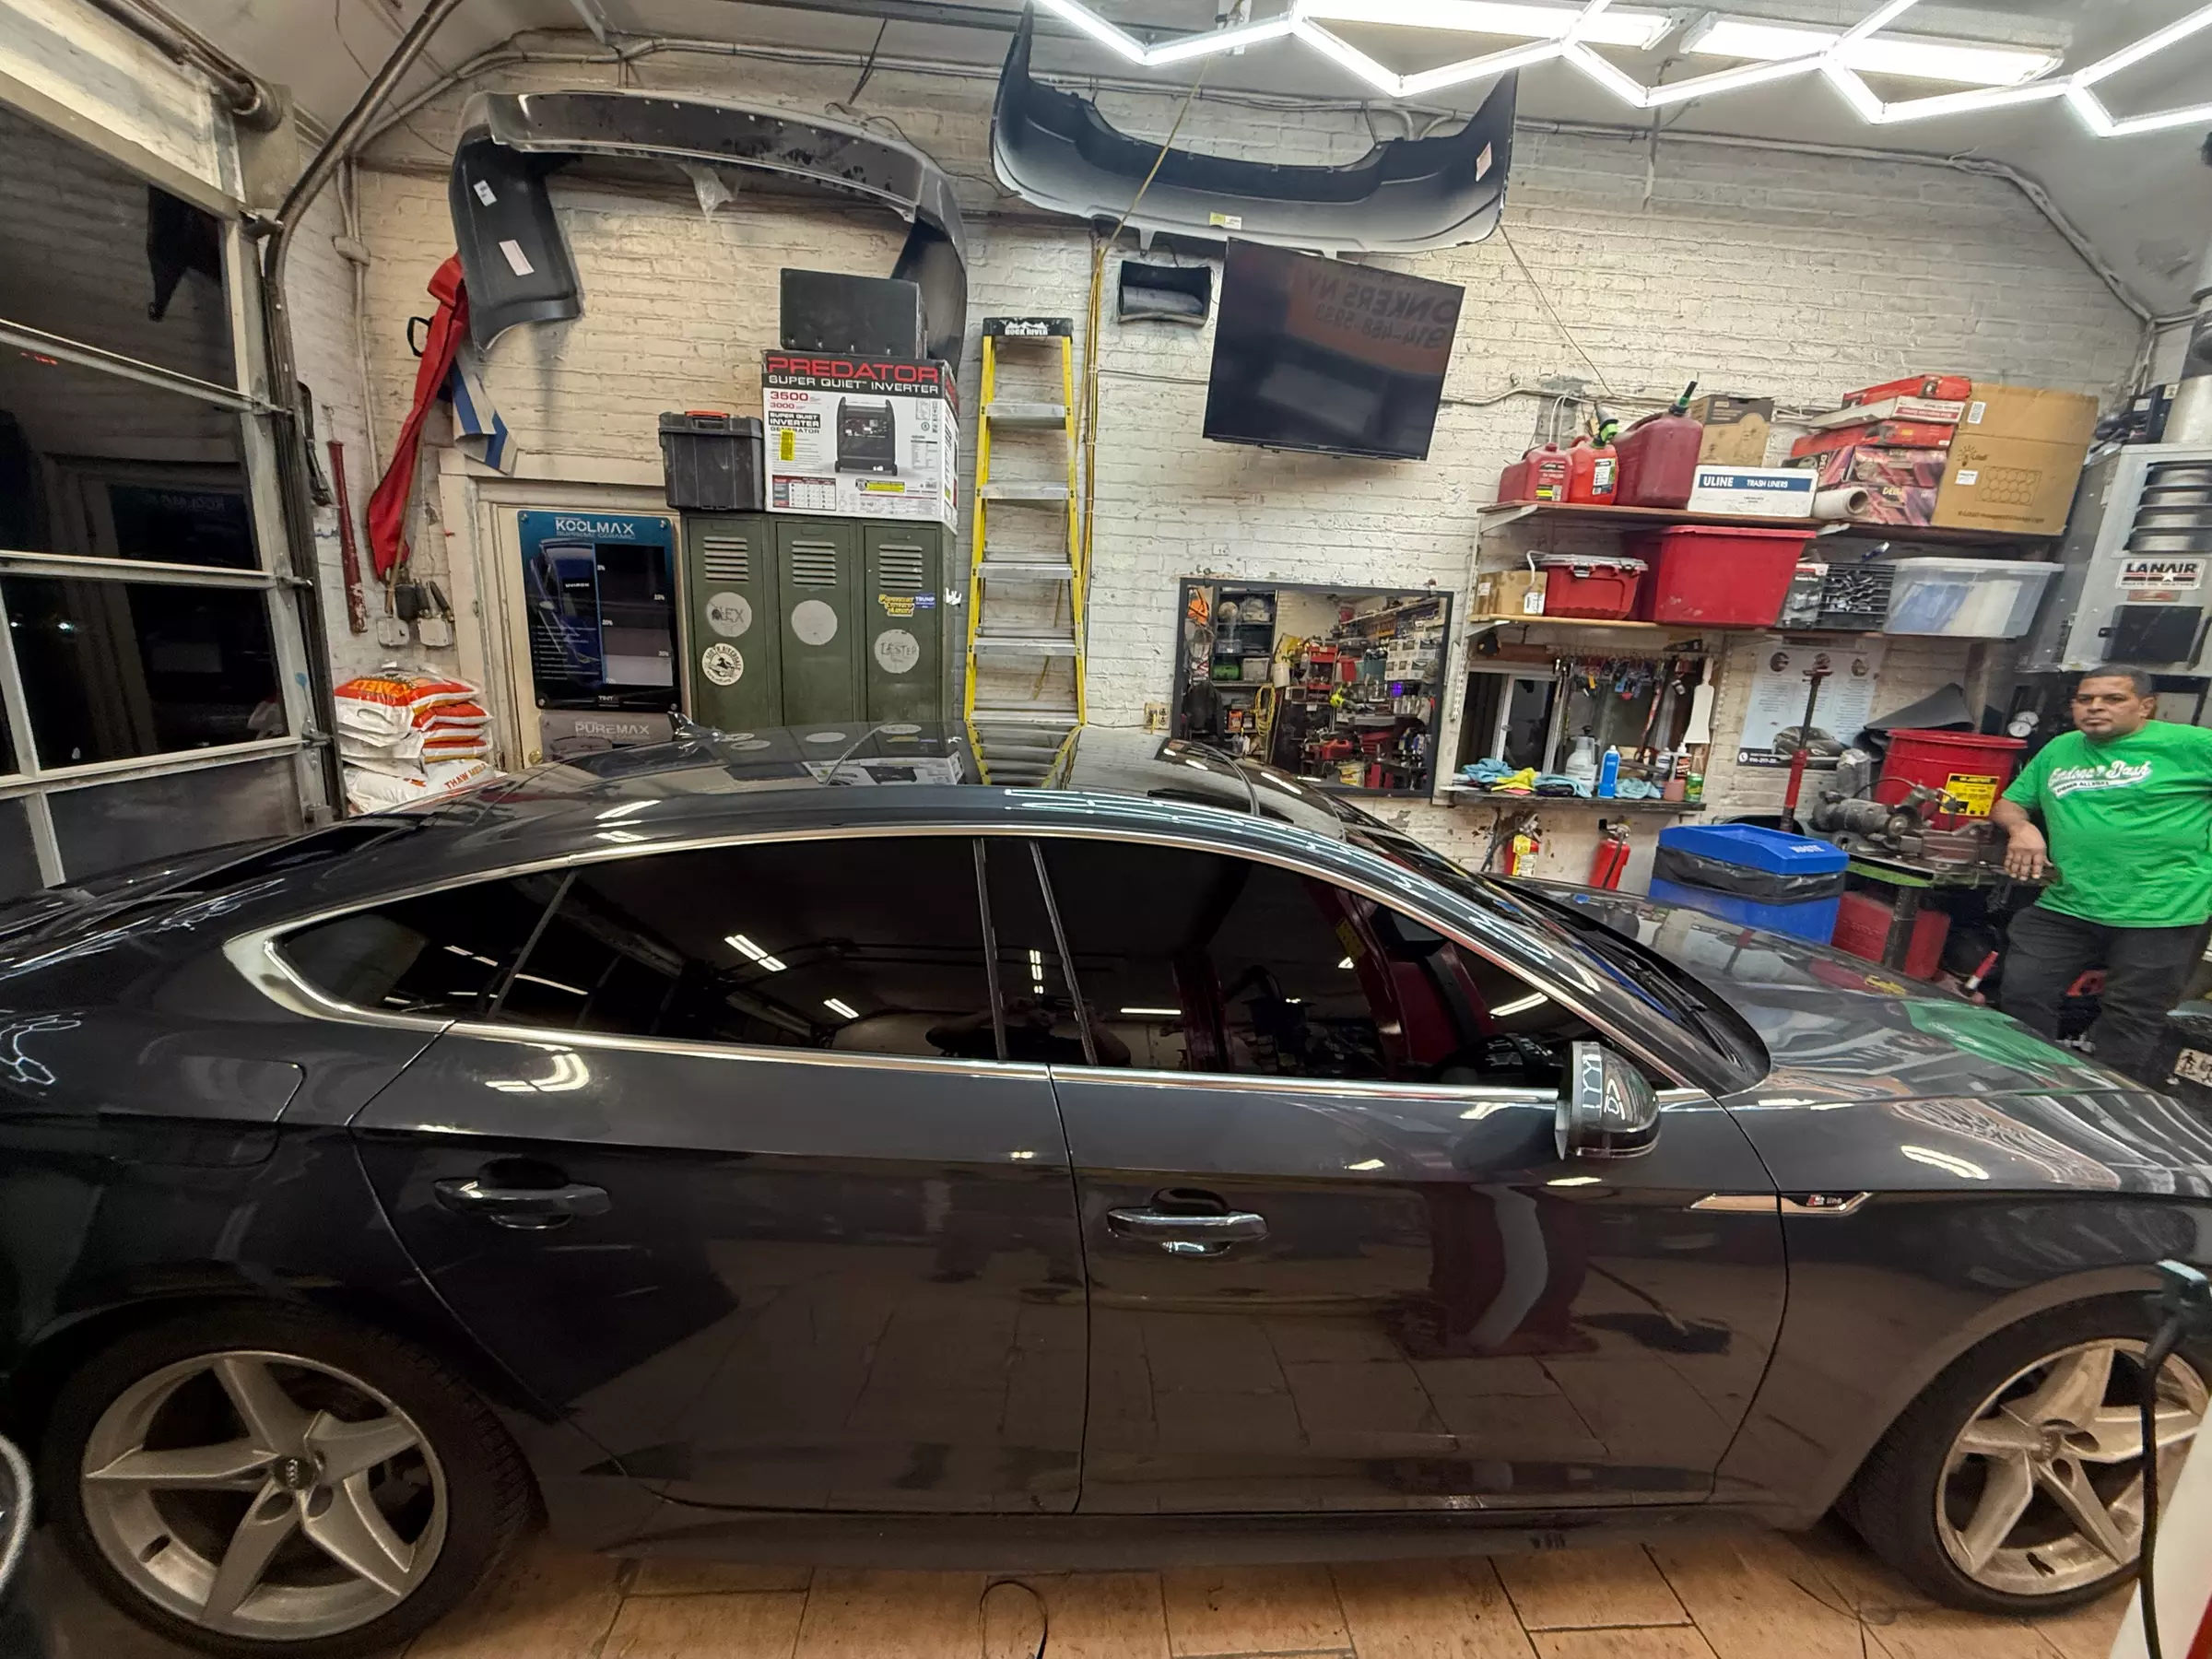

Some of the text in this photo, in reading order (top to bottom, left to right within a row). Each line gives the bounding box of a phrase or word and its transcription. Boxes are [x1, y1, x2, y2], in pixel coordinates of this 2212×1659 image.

[767, 357, 938, 383] PREDATOR
[769, 374, 816, 386] SUPER
[871, 382, 938, 394] INVERTER
[771, 391, 809, 401] 3500
[770, 418, 819, 428] INVERTER
[1703, 476, 1734, 487] ULINE
[1747, 479, 1789, 488] TRASH LINERS
[555, 519, 635, 535] KOOLMAX
[2126, 563, 2197, 573] LANAIR
[575, 722, 650, 735] PUREMAX
[444, 772, 468, 789] THAW
